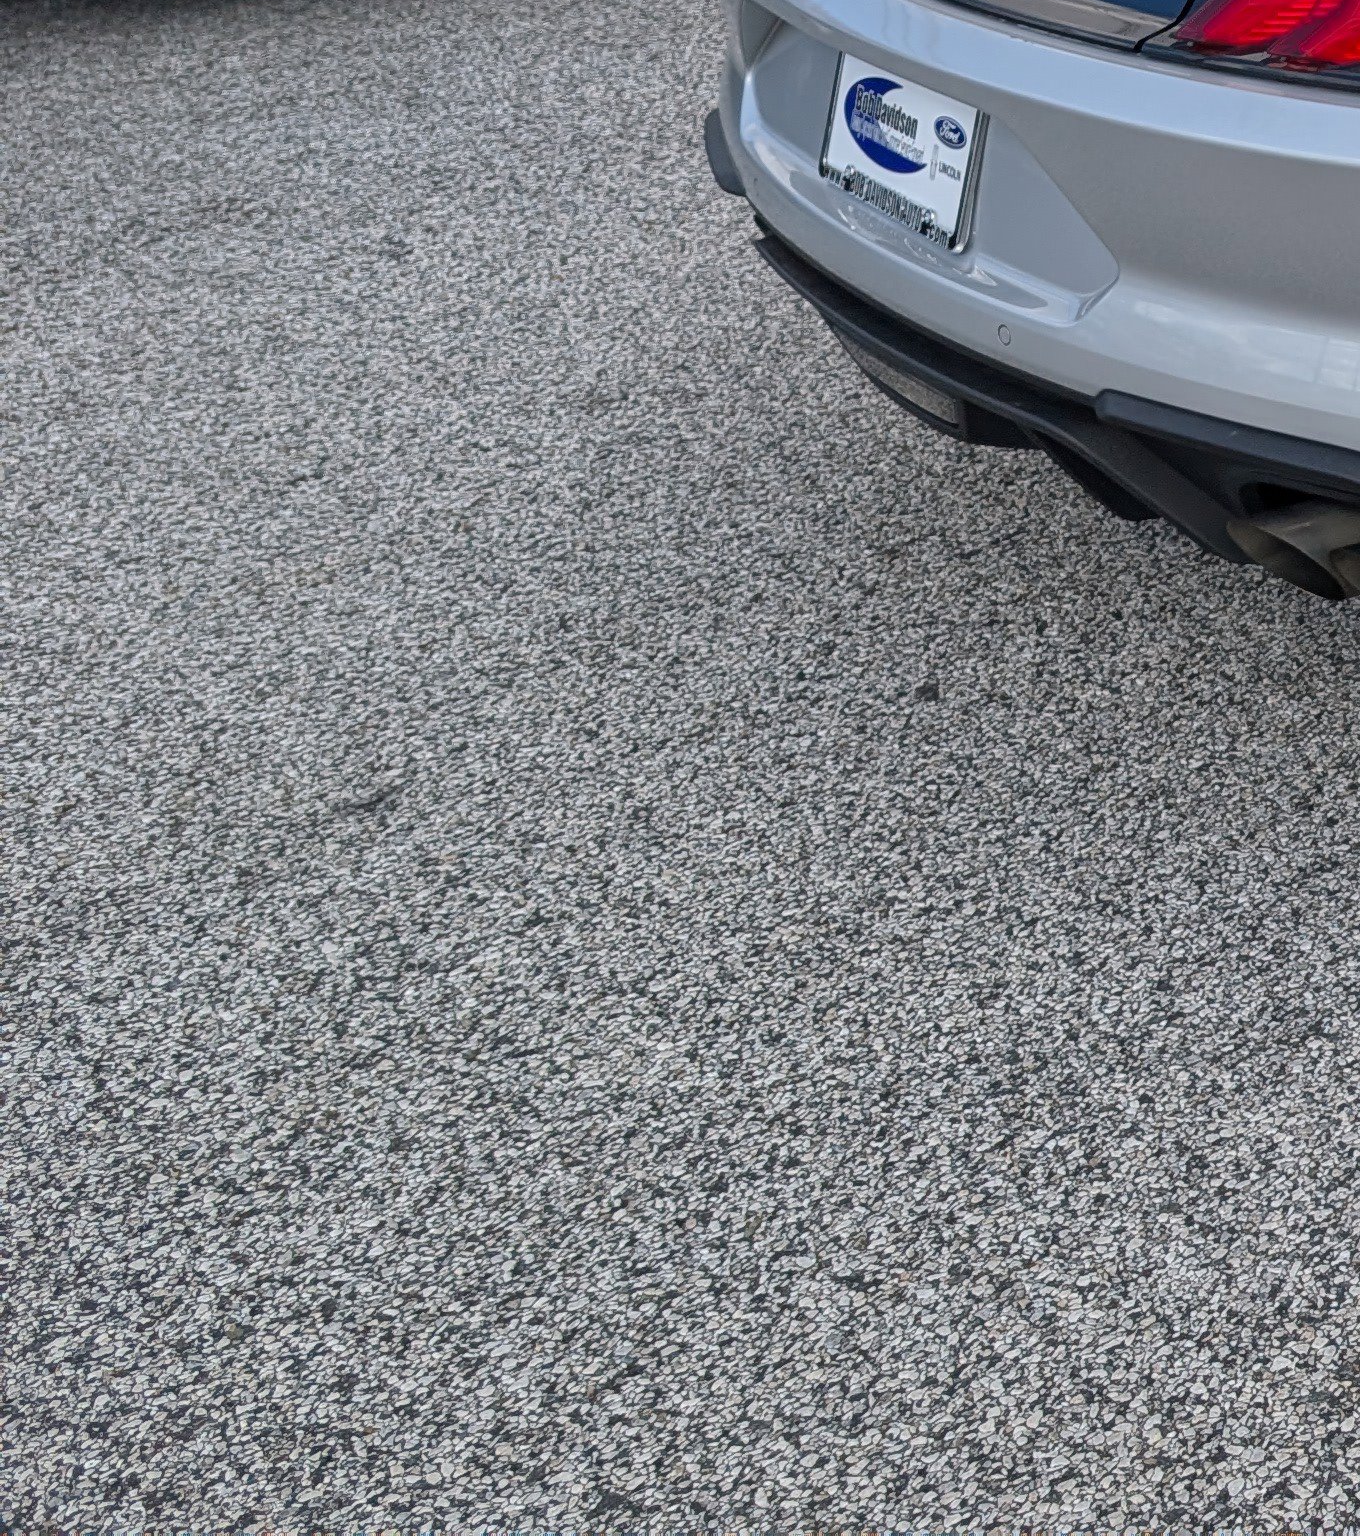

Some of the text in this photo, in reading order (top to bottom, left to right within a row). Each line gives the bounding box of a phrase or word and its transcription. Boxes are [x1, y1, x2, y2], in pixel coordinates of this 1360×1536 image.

[854, 83, 877, 118] Bob
[873, 93, 919, 141] Davidson
[938, 119, 961, 145] Ford
